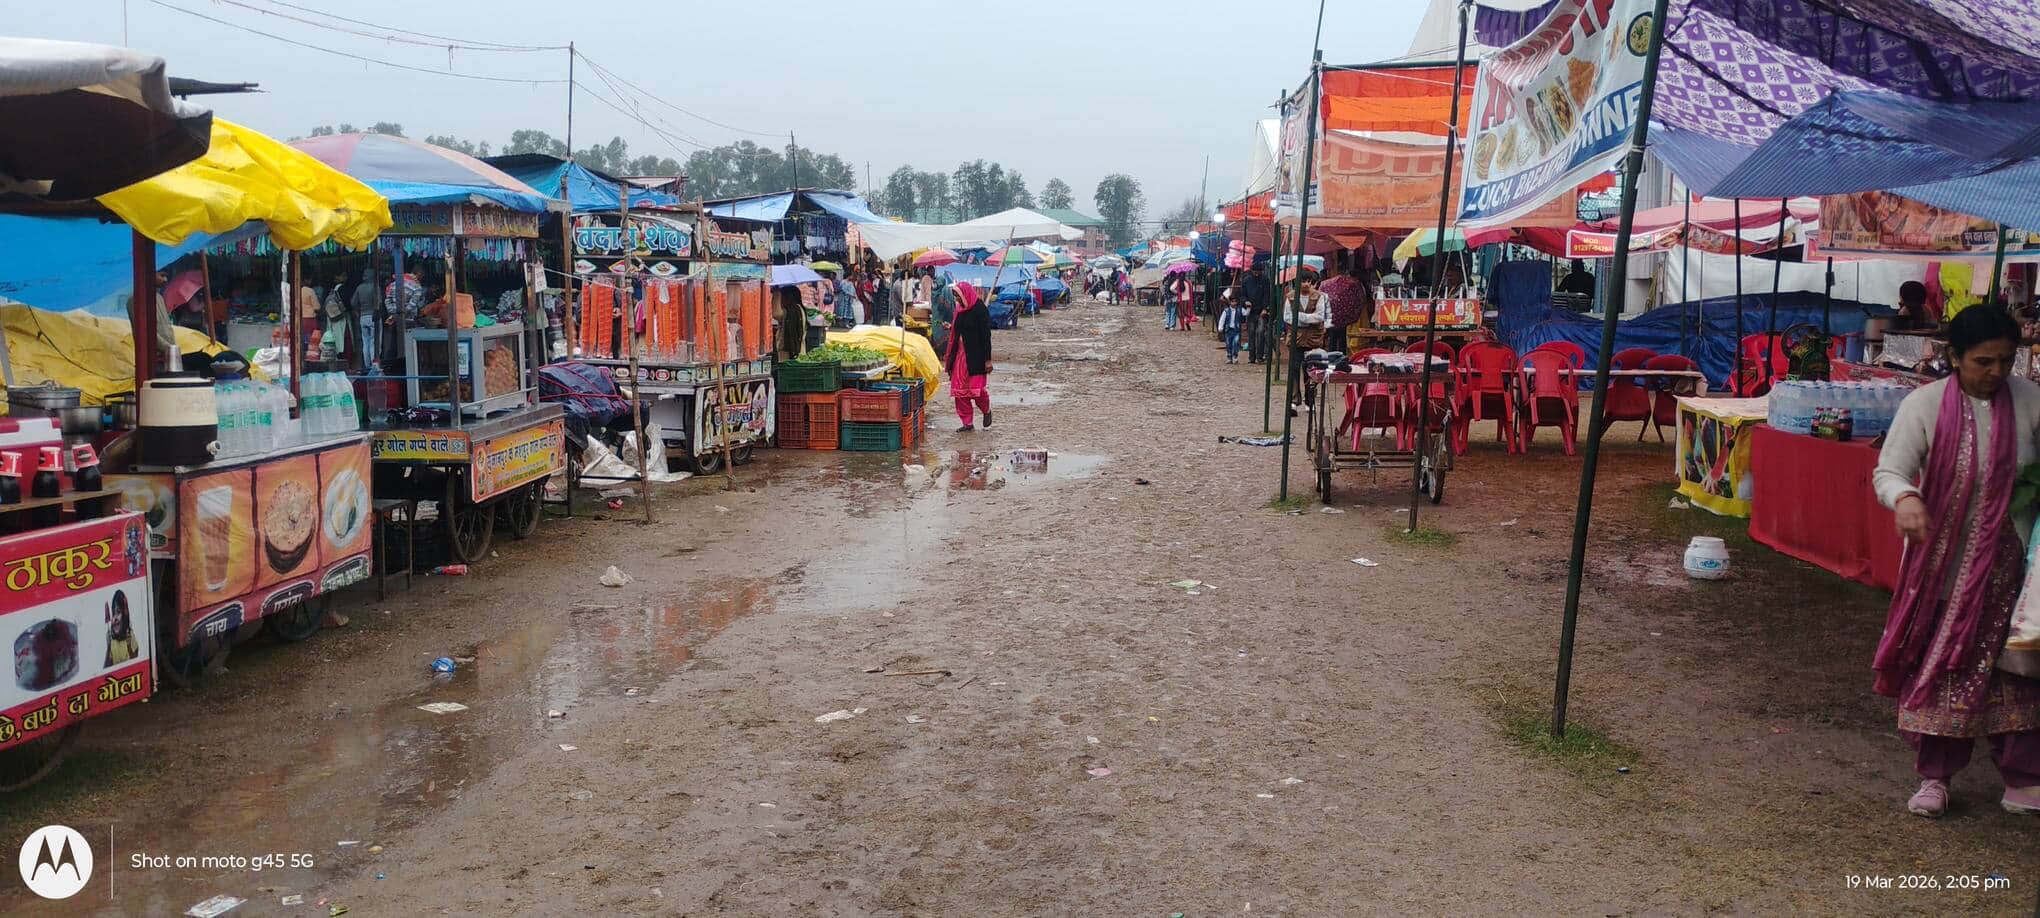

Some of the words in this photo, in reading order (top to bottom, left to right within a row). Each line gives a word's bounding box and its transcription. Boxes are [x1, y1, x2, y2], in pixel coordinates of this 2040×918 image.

[387, 434, 407, 451] गोल
[409, 434, 428, 451] गप्पे
[430, 433, 449, 451] वाले
[5, 538, 113, 591] ठाकुर
[68, 691, 90, 715] दा
[98, 672, 142, 702] गोला
